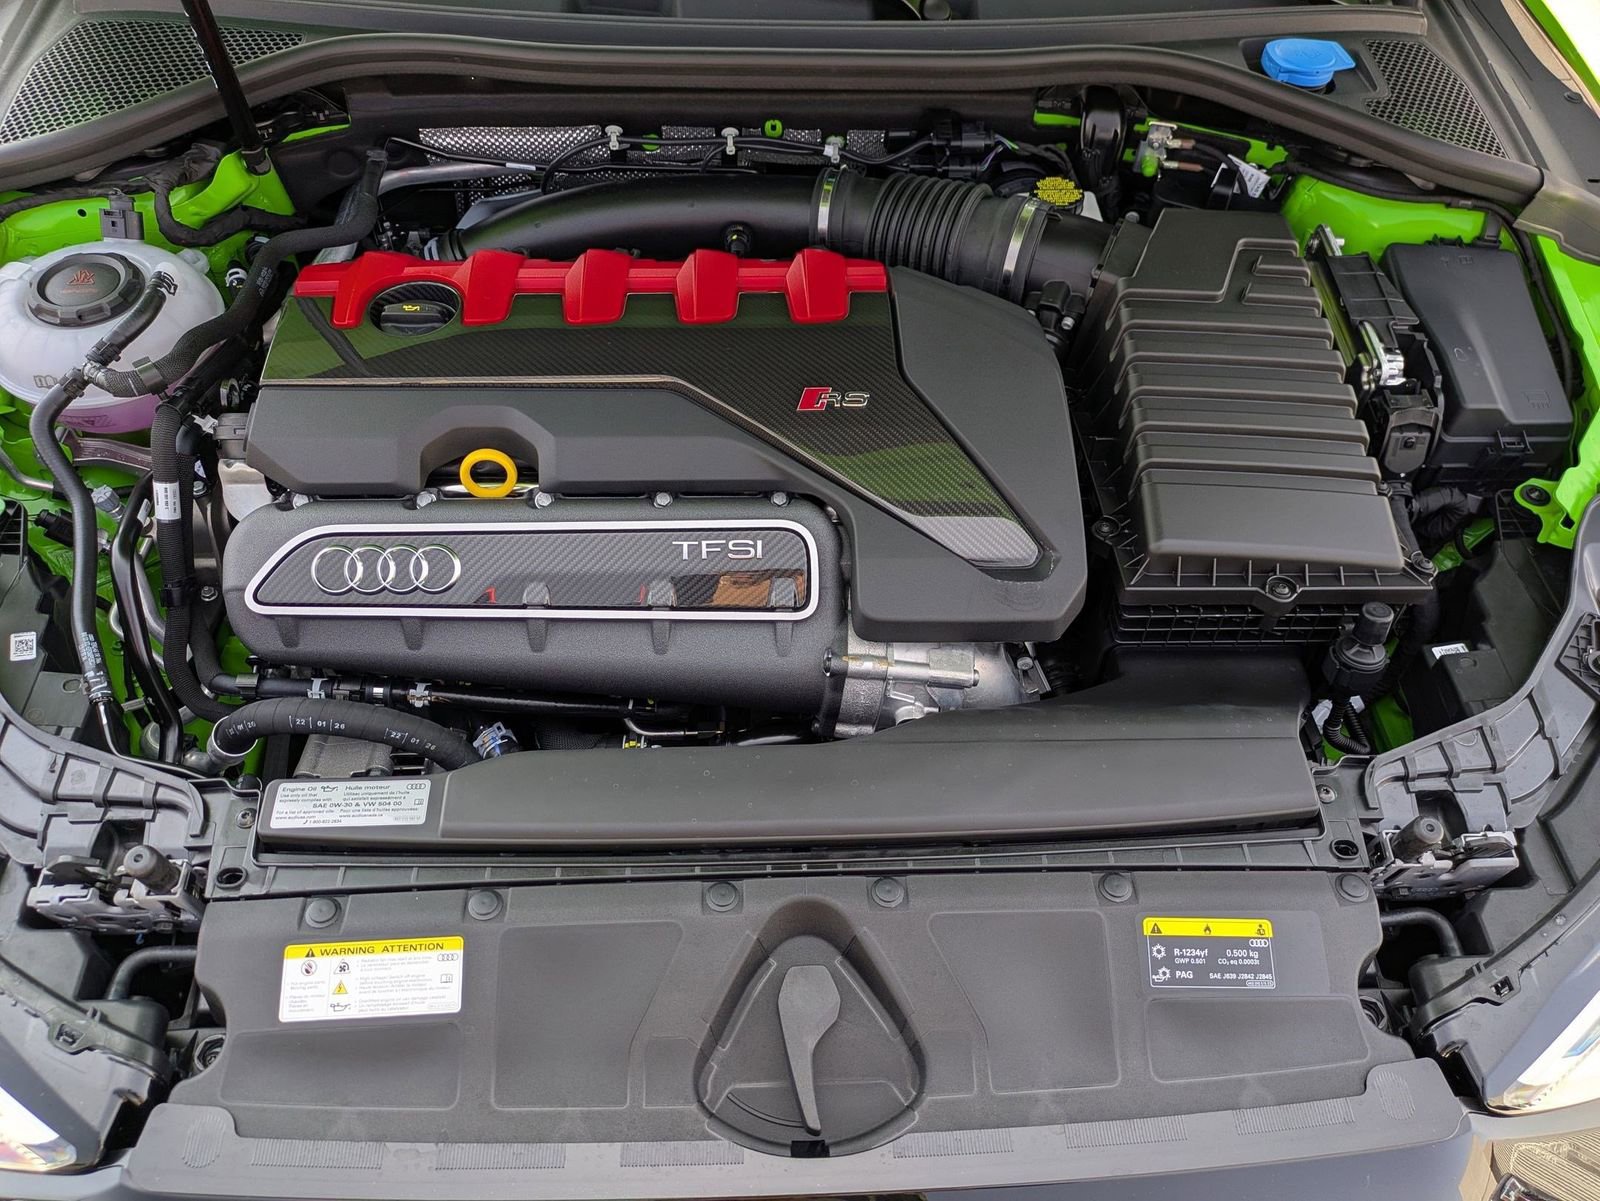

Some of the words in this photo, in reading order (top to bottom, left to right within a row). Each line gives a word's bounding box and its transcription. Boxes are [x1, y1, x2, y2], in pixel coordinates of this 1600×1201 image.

[808, 389, 870, 408] RS
[672, 539, 763, 560] TFSI
[295, 718, 306, 726] 22
[390, 731, 401, 739] 22
[320, 946, 375, 957] WARNING
[381, 942, 444, 953] ATTENTION
[1173, 948, 1208, 958] R-1234yf
[1226, 949, 1248, 957] 0.500
[1249, 950, 1259, 959] kg
[1175, 970, 1193, 979] PAG
